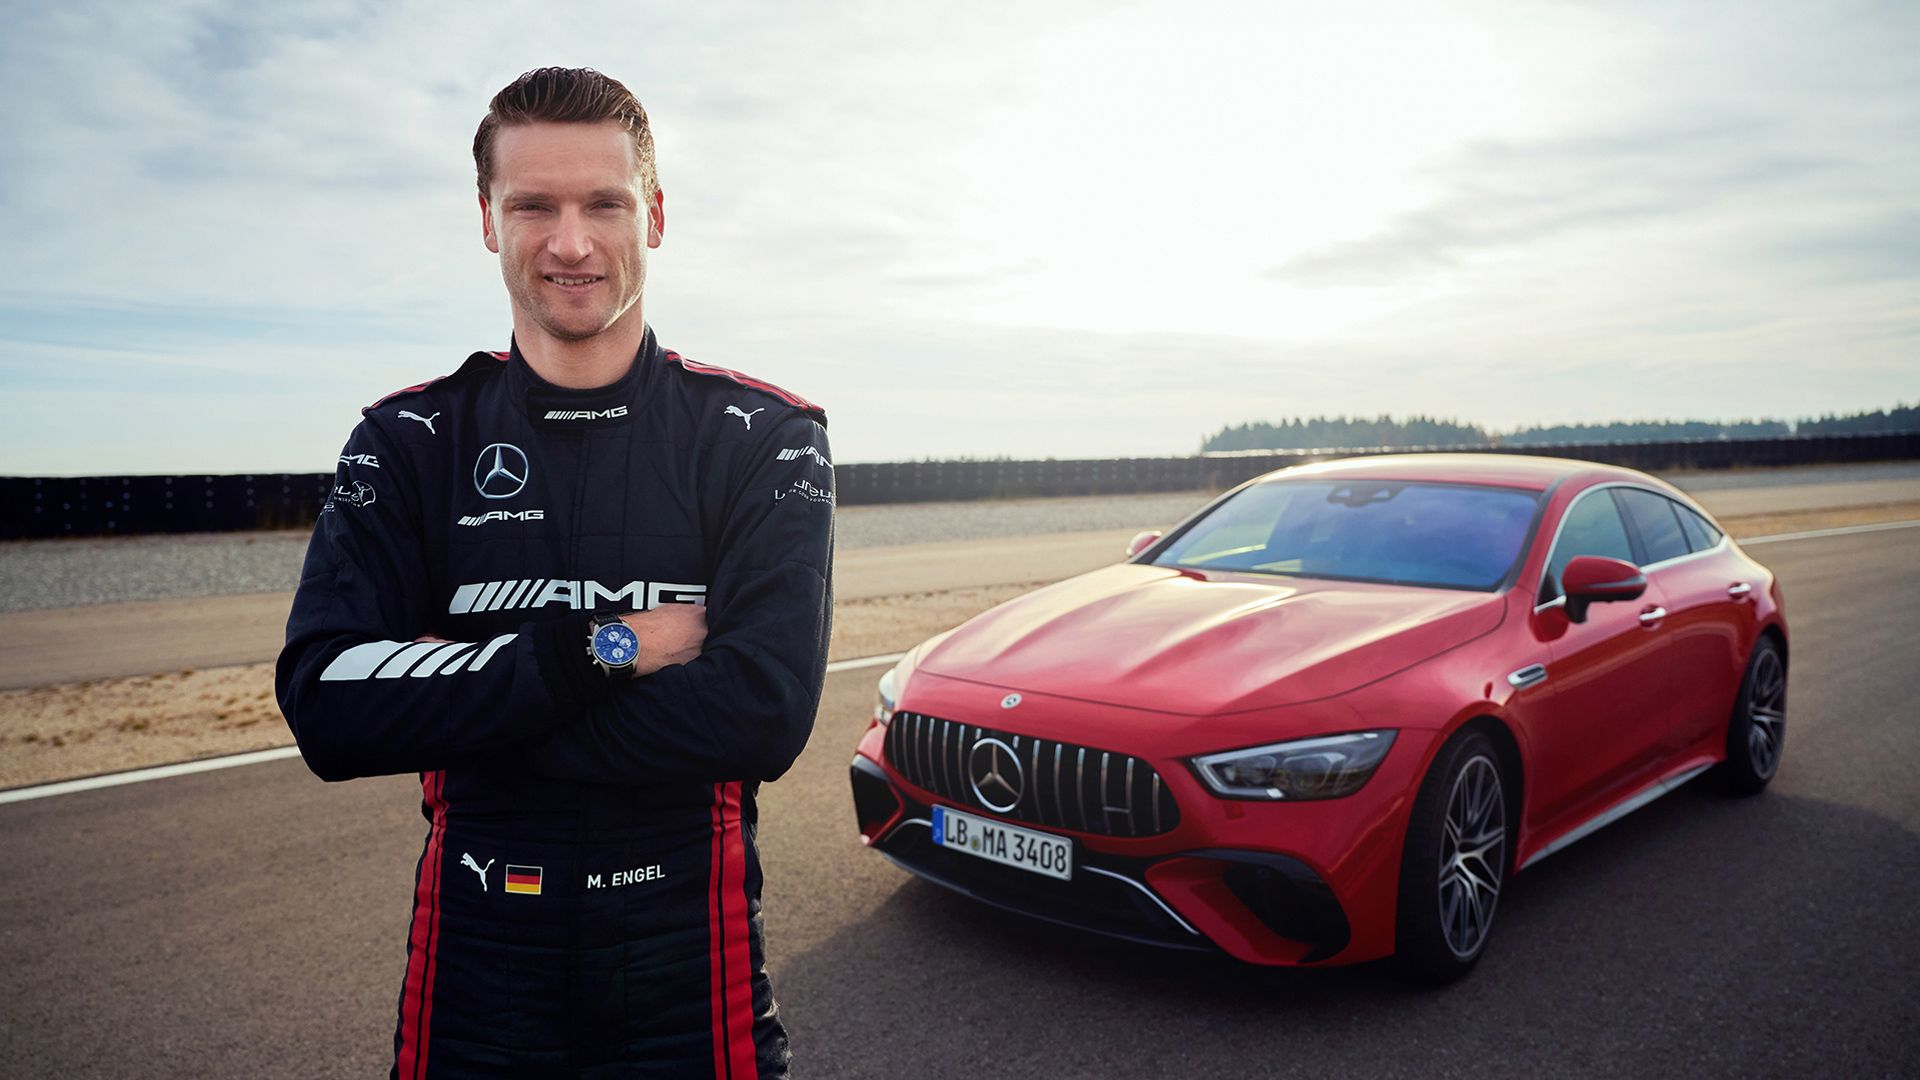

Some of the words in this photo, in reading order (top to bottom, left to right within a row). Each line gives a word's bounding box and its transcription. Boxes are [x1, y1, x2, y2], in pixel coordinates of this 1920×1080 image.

[570, 405, 629, 420] AMG
[483, 509, 545, 522] AMG
[531, 578, 707, 610] AMG
[944, 814, 968, 846] LB
[982, 825, 1008, 859] MA
[1012, 833, 1067, 873] 3408
[587, 873, 607, 889] M.
[611, 864, 666, 887] ENGEL
